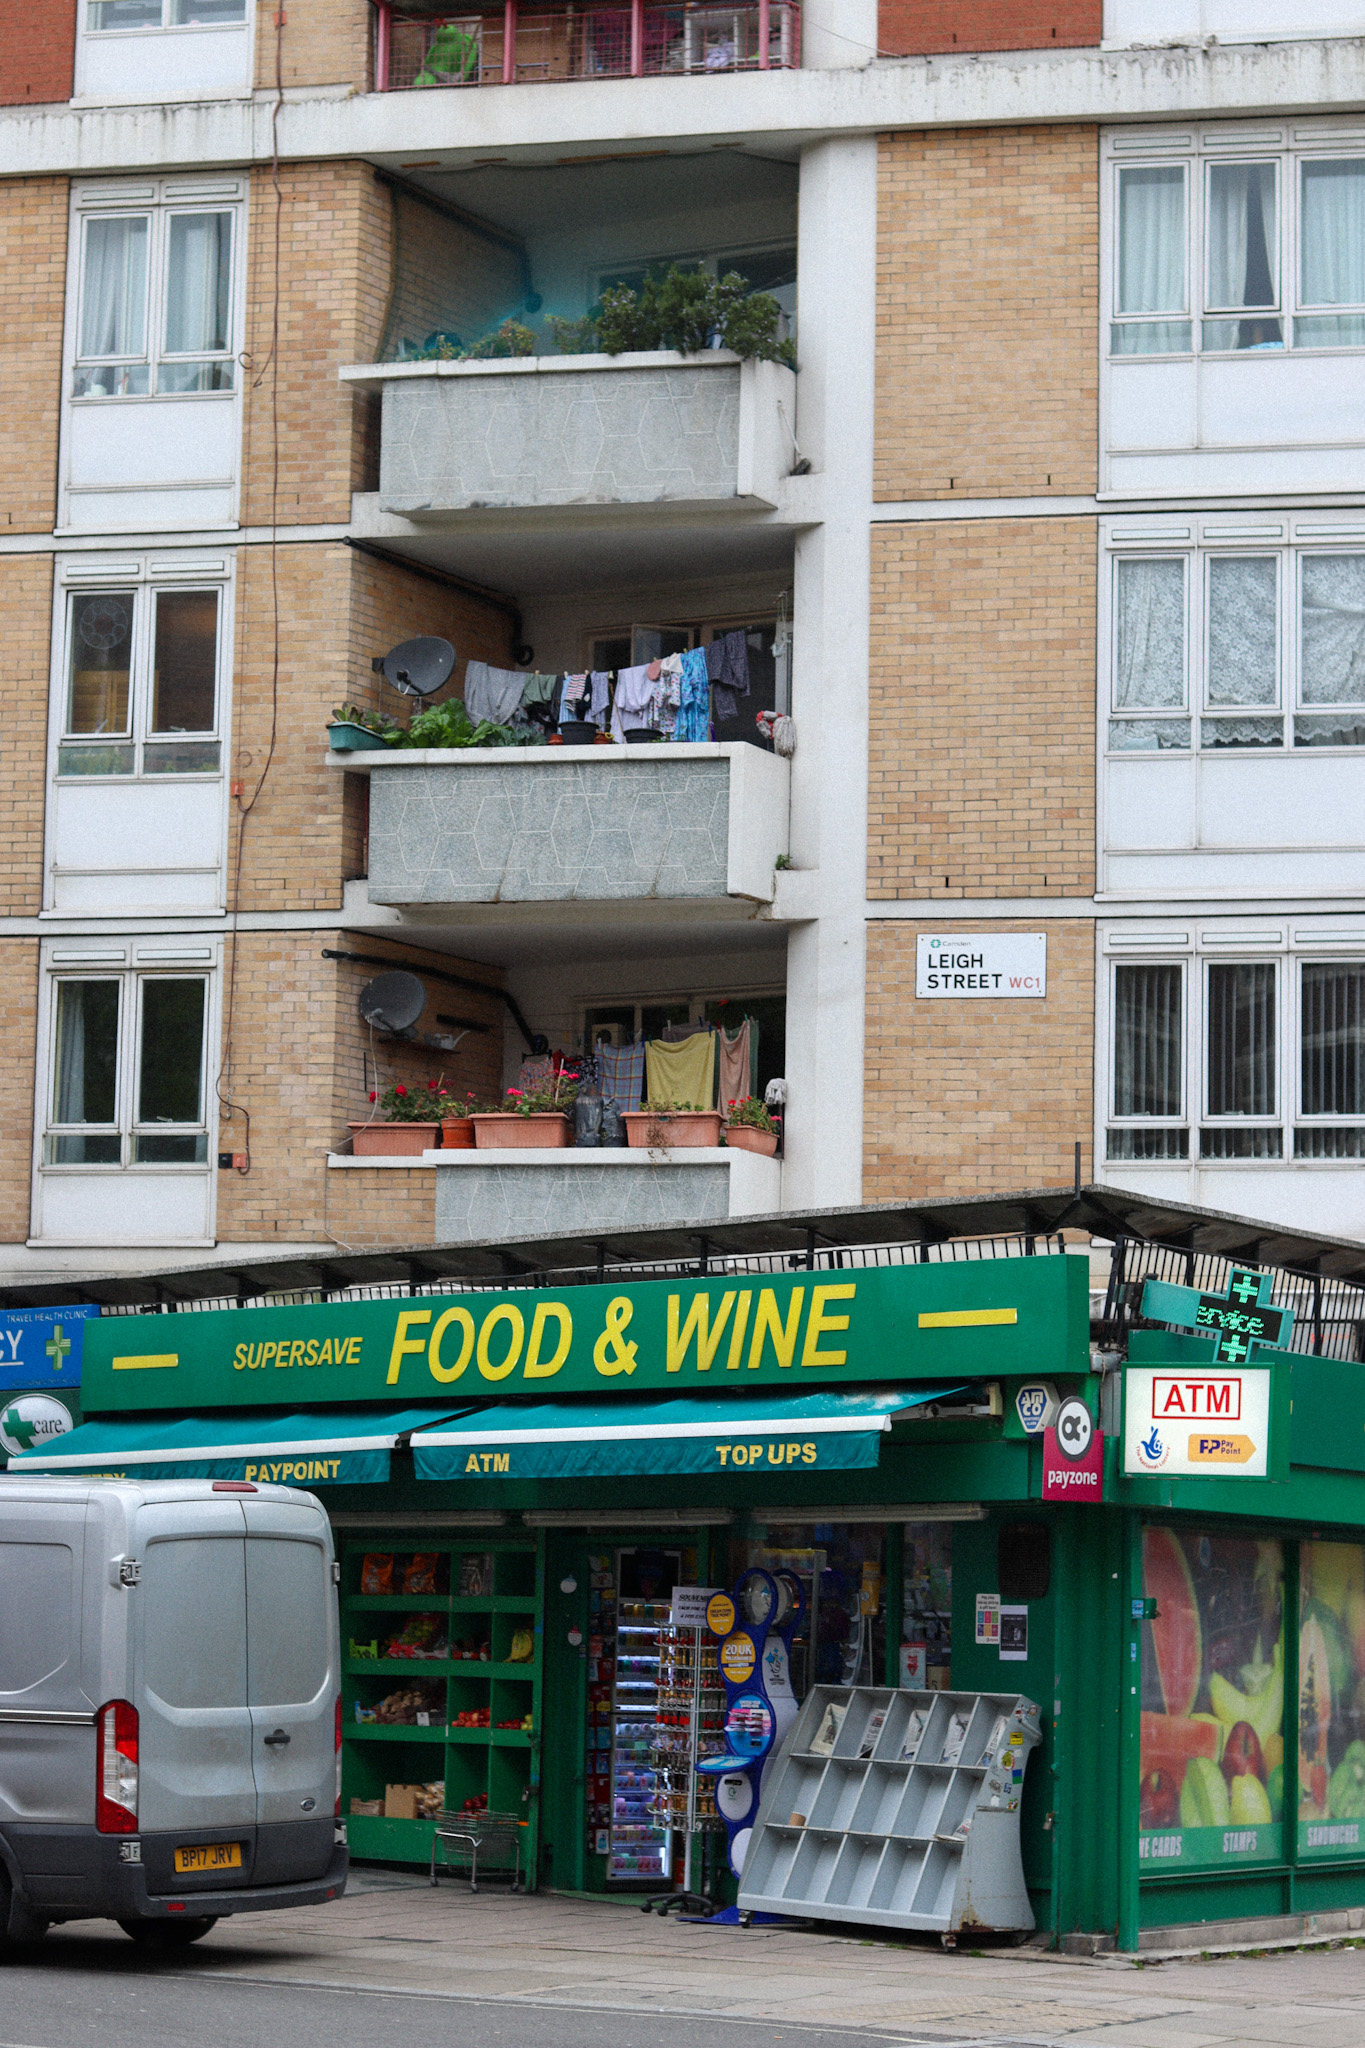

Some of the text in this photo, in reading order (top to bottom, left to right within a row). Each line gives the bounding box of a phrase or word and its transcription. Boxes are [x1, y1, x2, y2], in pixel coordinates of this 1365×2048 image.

[928, 953, 984, 969] LEIGH
[927, 974, 1041, 989] STREET WC1
[7, 1309, 88, 1323] TRAVEL HEALTH CLINIC
[386, 1283, 857, 1385] FOOD & WINE
[233, 1336, 364, 1371] SUPERSAVE
[1163, 1384, 1231, 1413] ATM
[715, 1443, 817, 1466] TOP UPS
[1221, 1440, 1234, 1448] Pay
[1221, 1447, 1241, 1455] Point
[245, 1459, 341, 1482] PAYPOINT
[465, 1453, 510, 1473] ATM
[1047, 1470, 1098, 1489] payzone
[725, 1644, 752, 1655] 20 UK
[1223, 1830, 1257, 1853] STAMPS
[1307, 1824, 1359, 1847] SANDWICHES
[181, 1846, 233, 1867] BP17 JRV
[1151, 1835, 1183, 1858] CARDS
